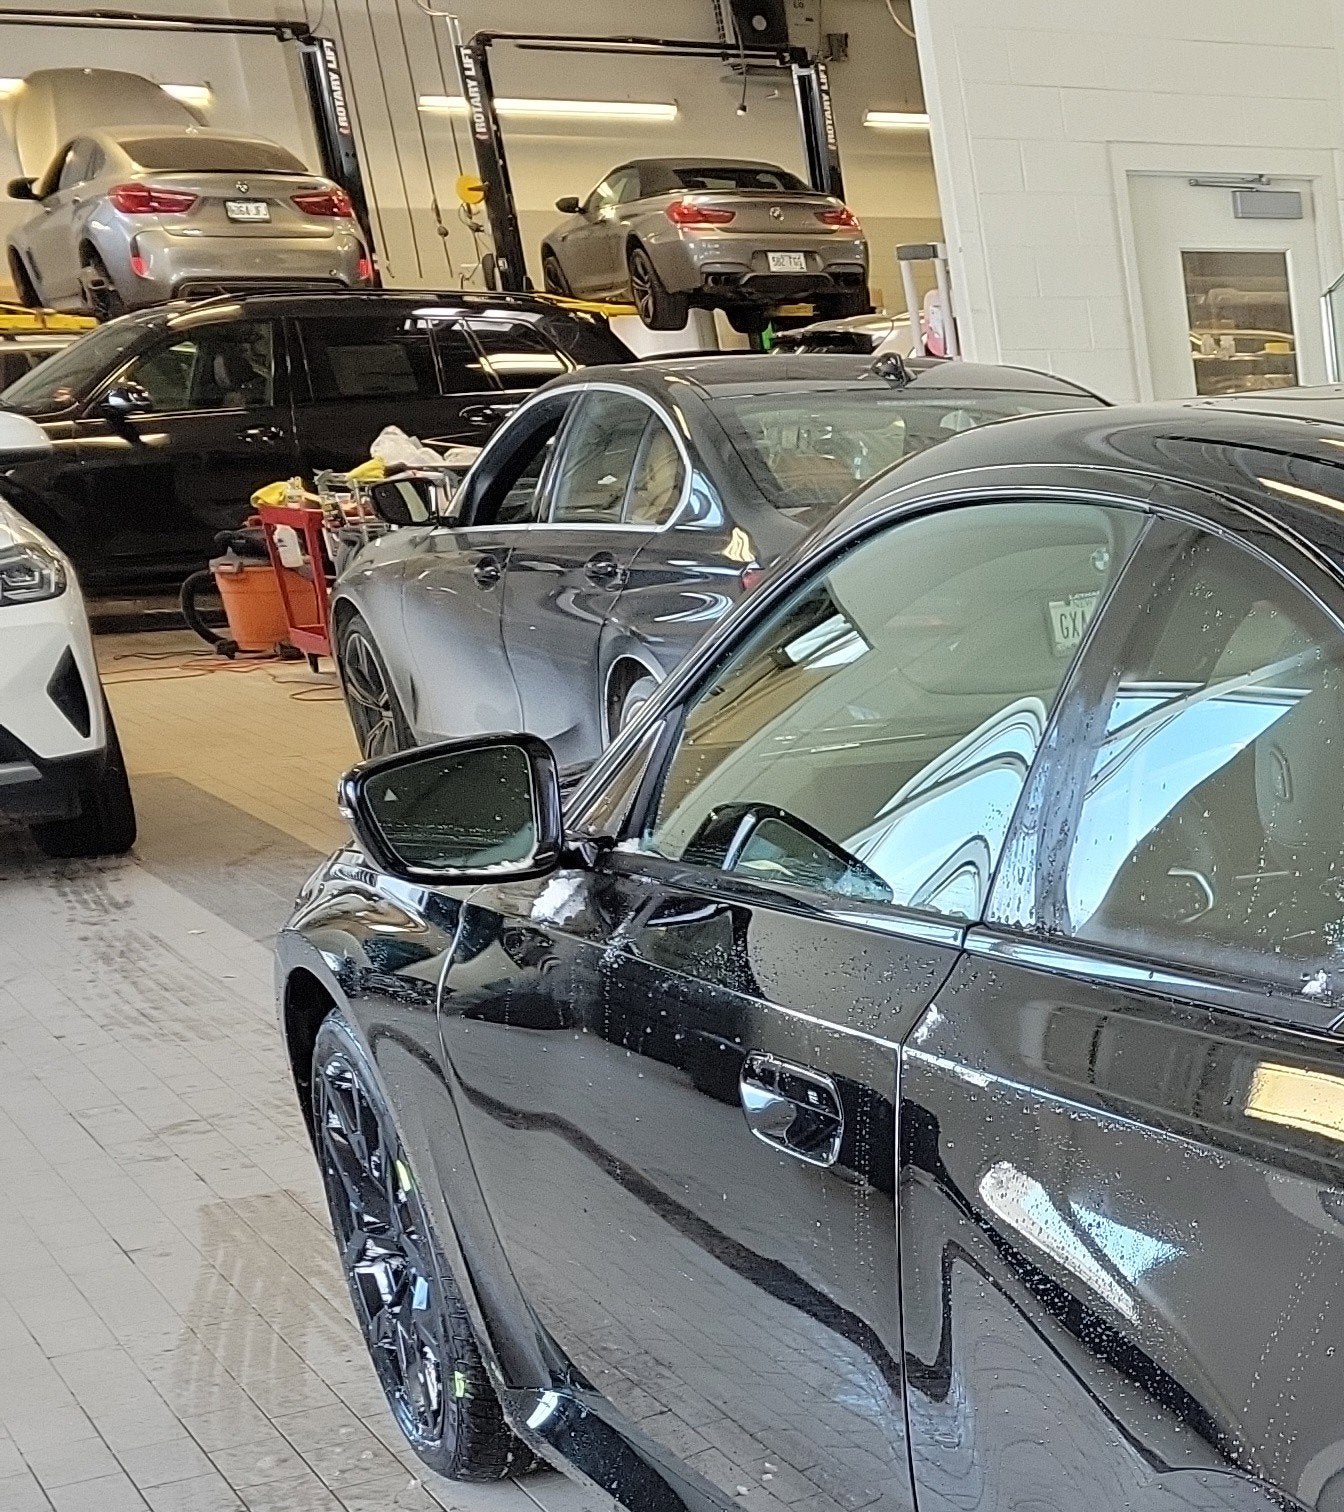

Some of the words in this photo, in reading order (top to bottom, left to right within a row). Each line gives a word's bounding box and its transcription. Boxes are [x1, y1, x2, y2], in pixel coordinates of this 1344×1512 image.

[321, 38, 339, 70] LIFT
[459, 46, 477, 77] LIFT
[328, 72, 350, 128] ROTARY
[465, 79, 487, 134] ROTARY
[821, 92, 836, 143] ROTARY
